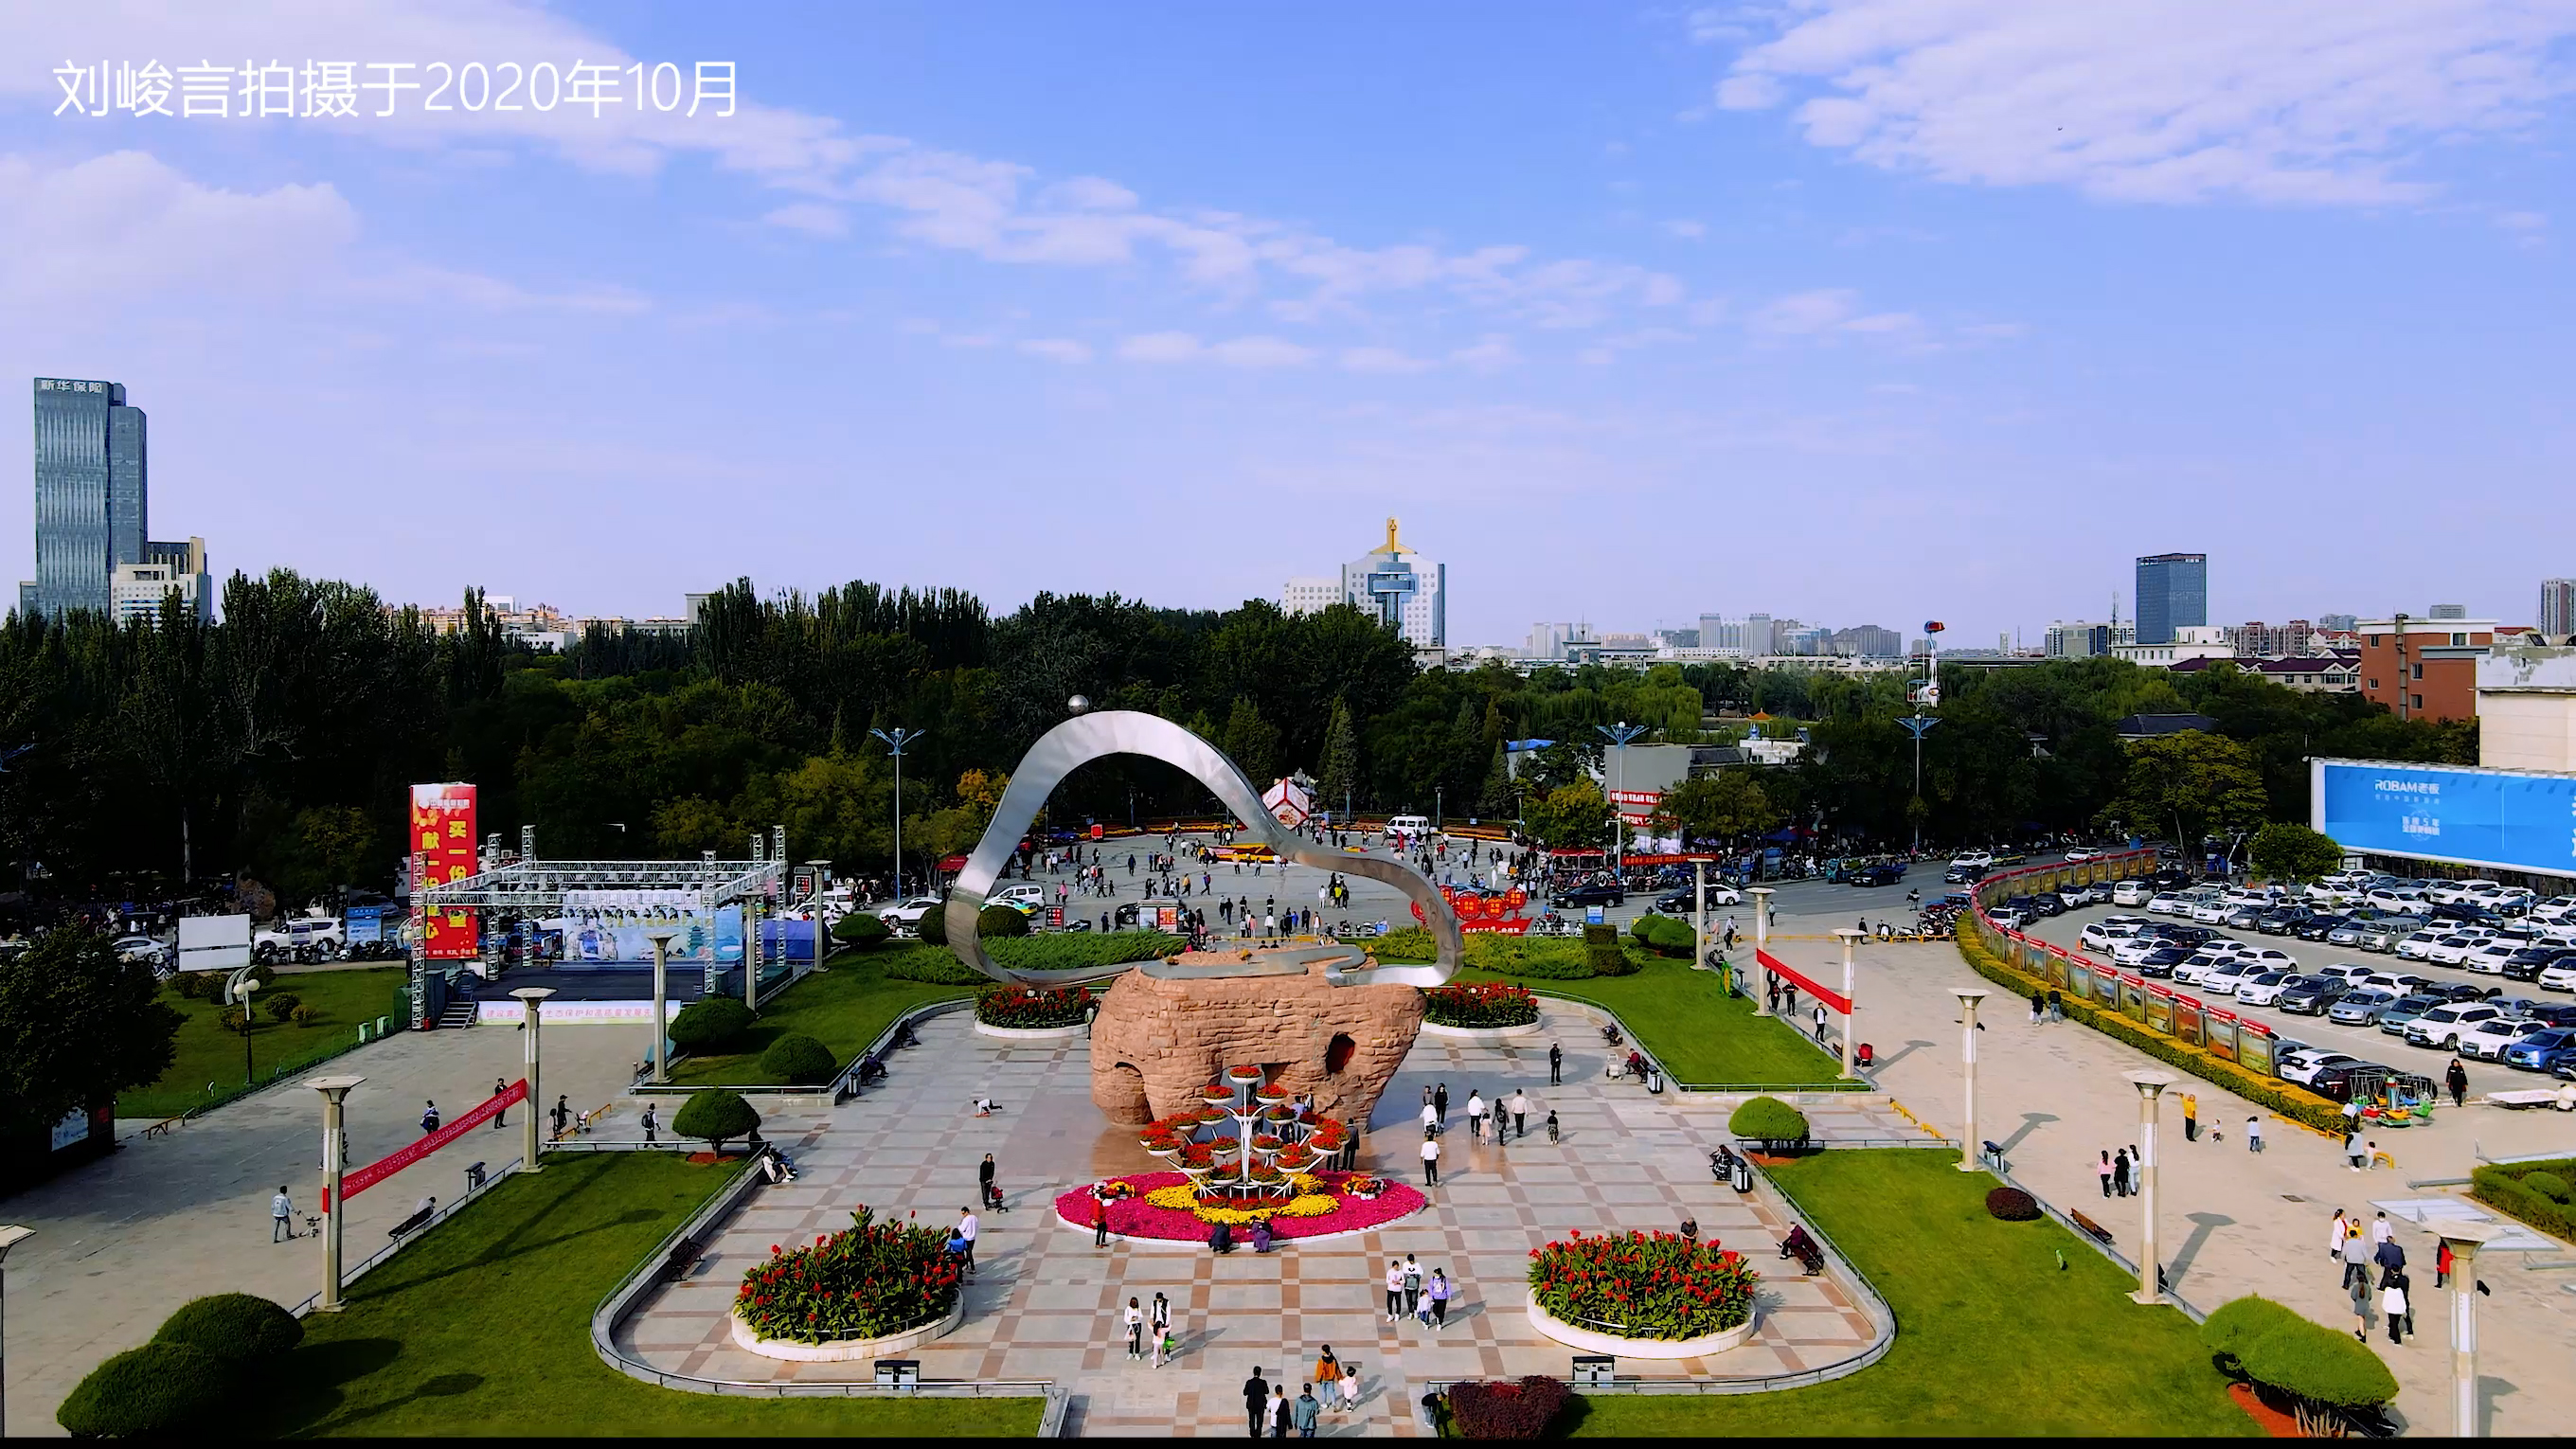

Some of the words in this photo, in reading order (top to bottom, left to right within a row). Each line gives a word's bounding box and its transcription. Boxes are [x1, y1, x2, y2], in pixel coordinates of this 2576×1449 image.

[41, 380, 102, 393] 新华保险
[448, 820, 468, 927] 买一份望
[486, 1008, 671, 1018] 建设黄河生态保护和高质量发展先区
